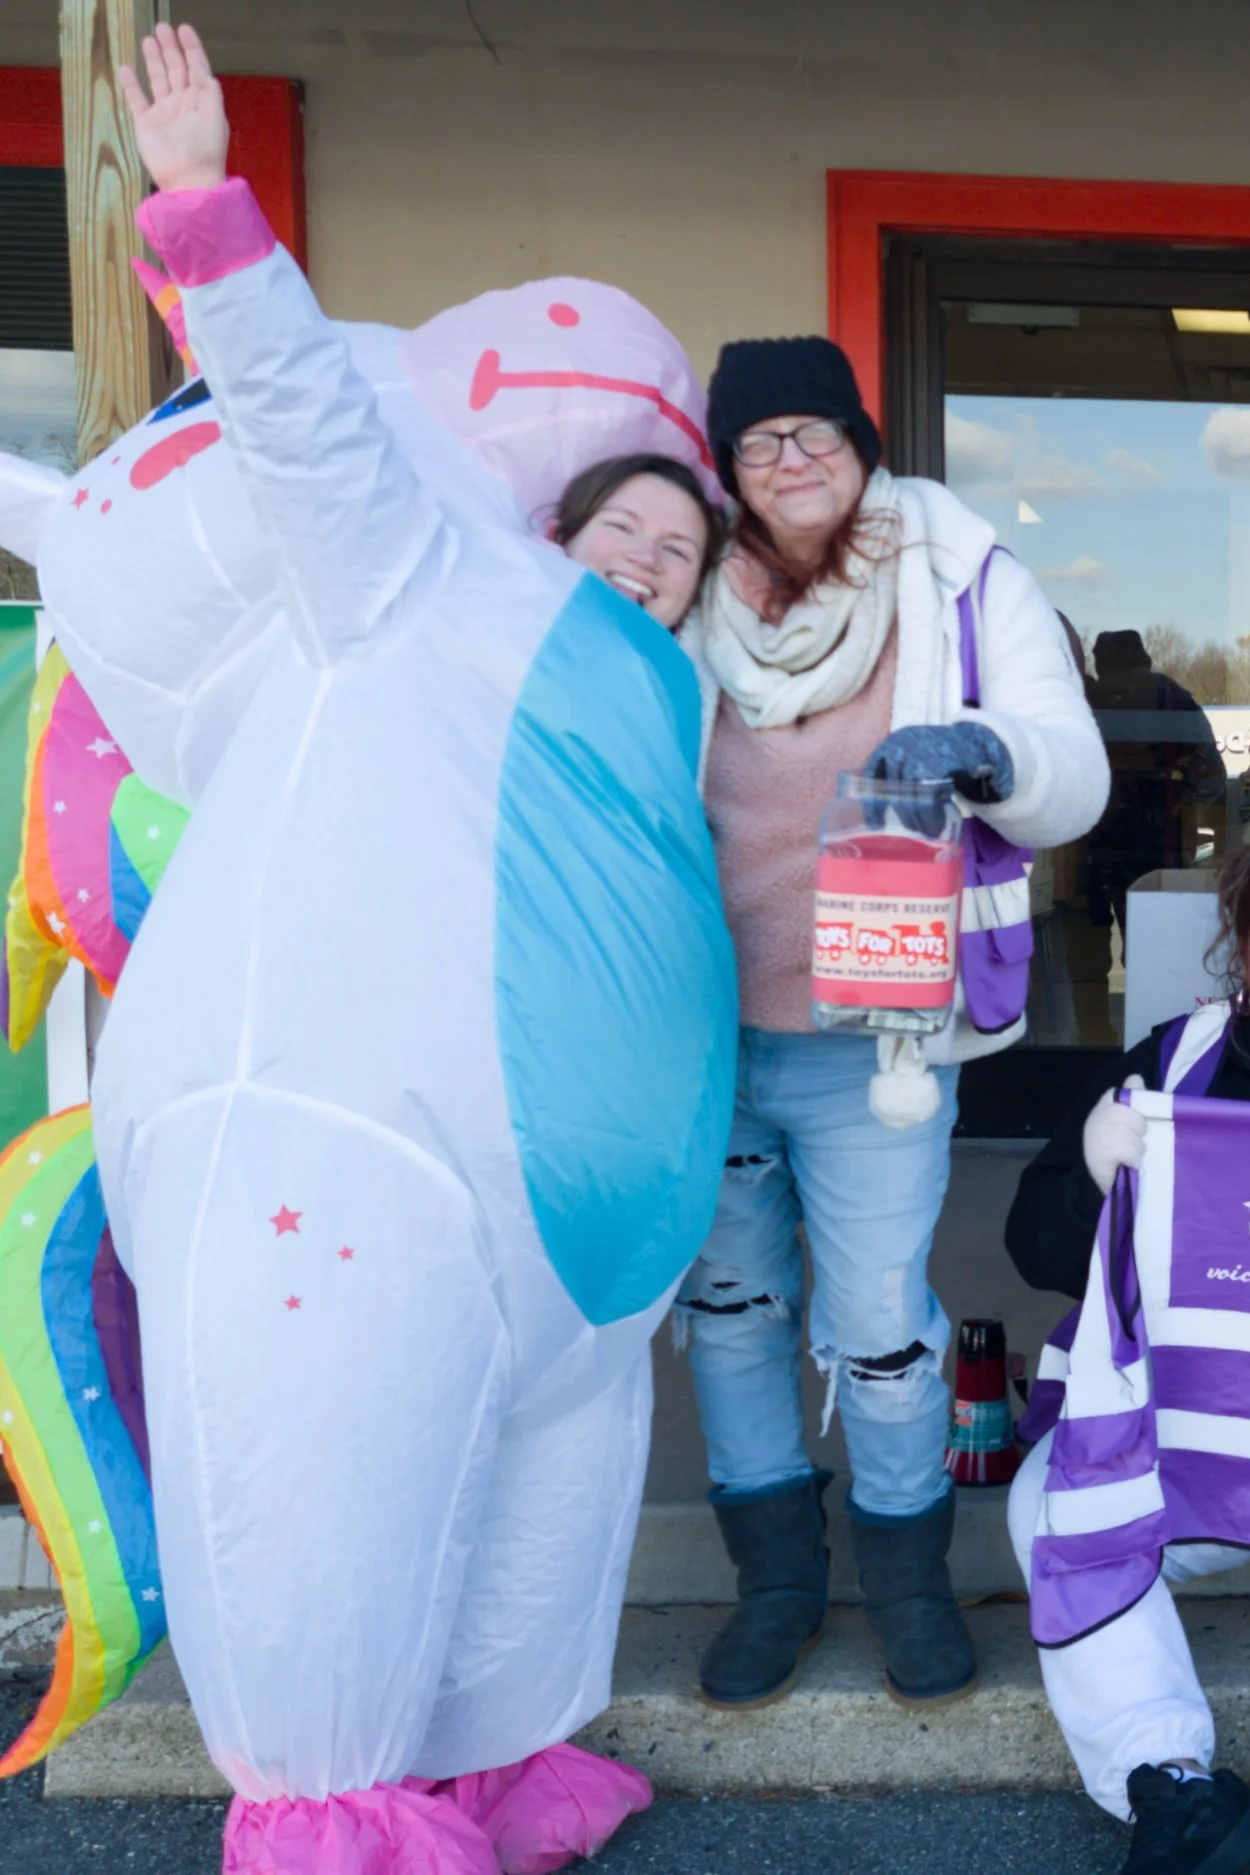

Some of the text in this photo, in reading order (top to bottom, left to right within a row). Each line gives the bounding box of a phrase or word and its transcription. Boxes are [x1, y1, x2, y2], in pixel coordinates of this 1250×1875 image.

[860, 901, 899, 914] CORPS
[858, 931, 893, 955] FOR
[902, 936, 945, 957] TOTS
